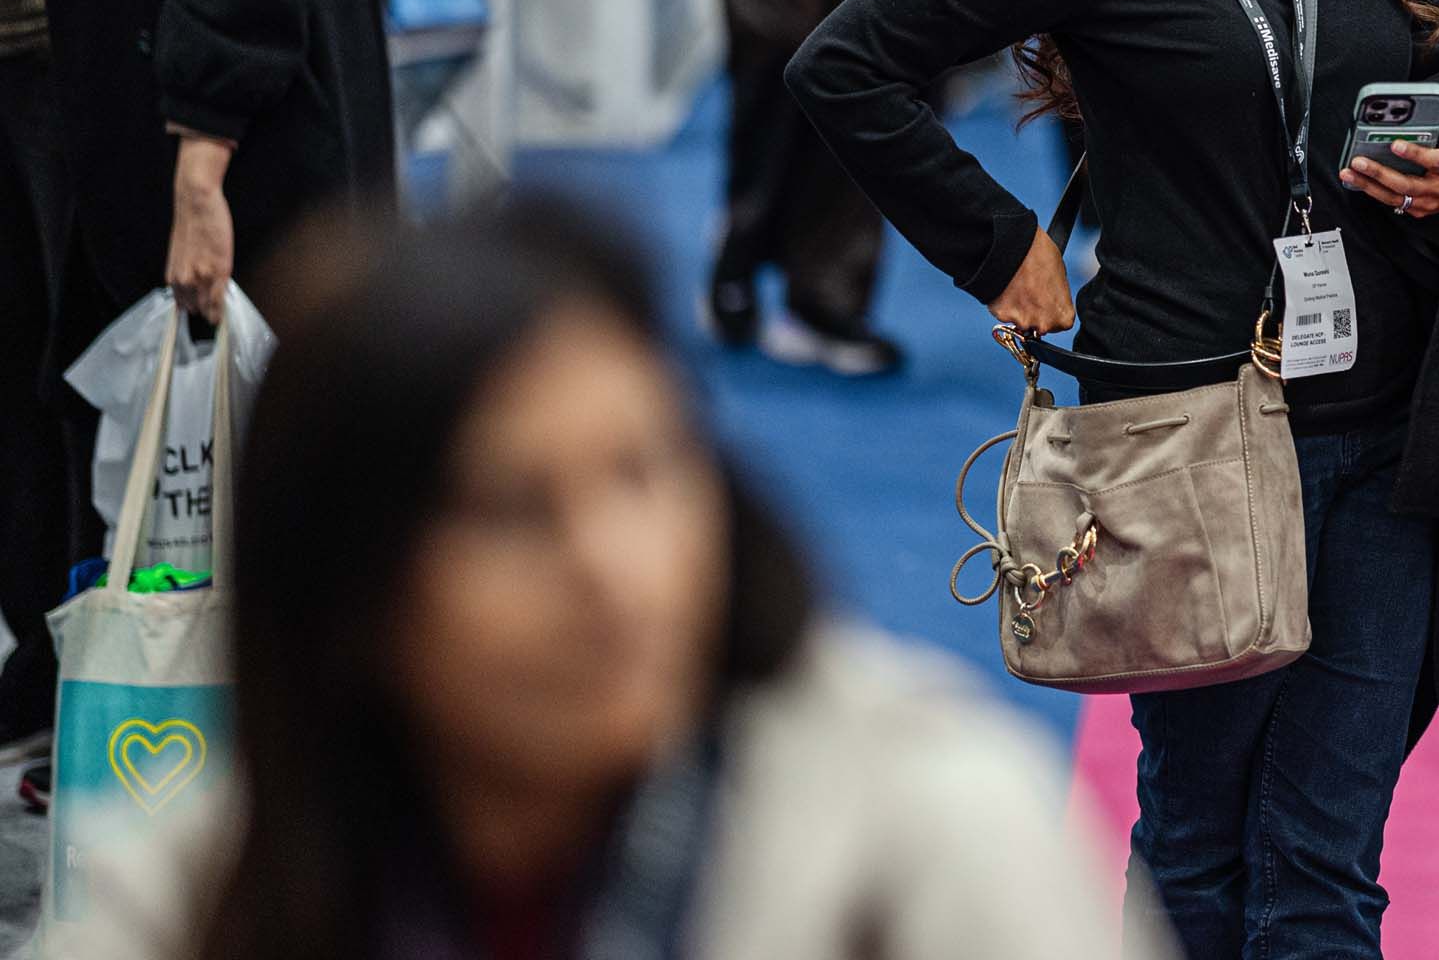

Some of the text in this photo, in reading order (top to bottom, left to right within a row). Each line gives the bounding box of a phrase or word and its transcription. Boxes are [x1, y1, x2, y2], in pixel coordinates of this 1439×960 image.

[1260, 29, 1281, 88] Medisave
[1292, 332, 1314, 340] DELEGATE
[1290, 338, 1326, 348] LOUNGE ACCESS
